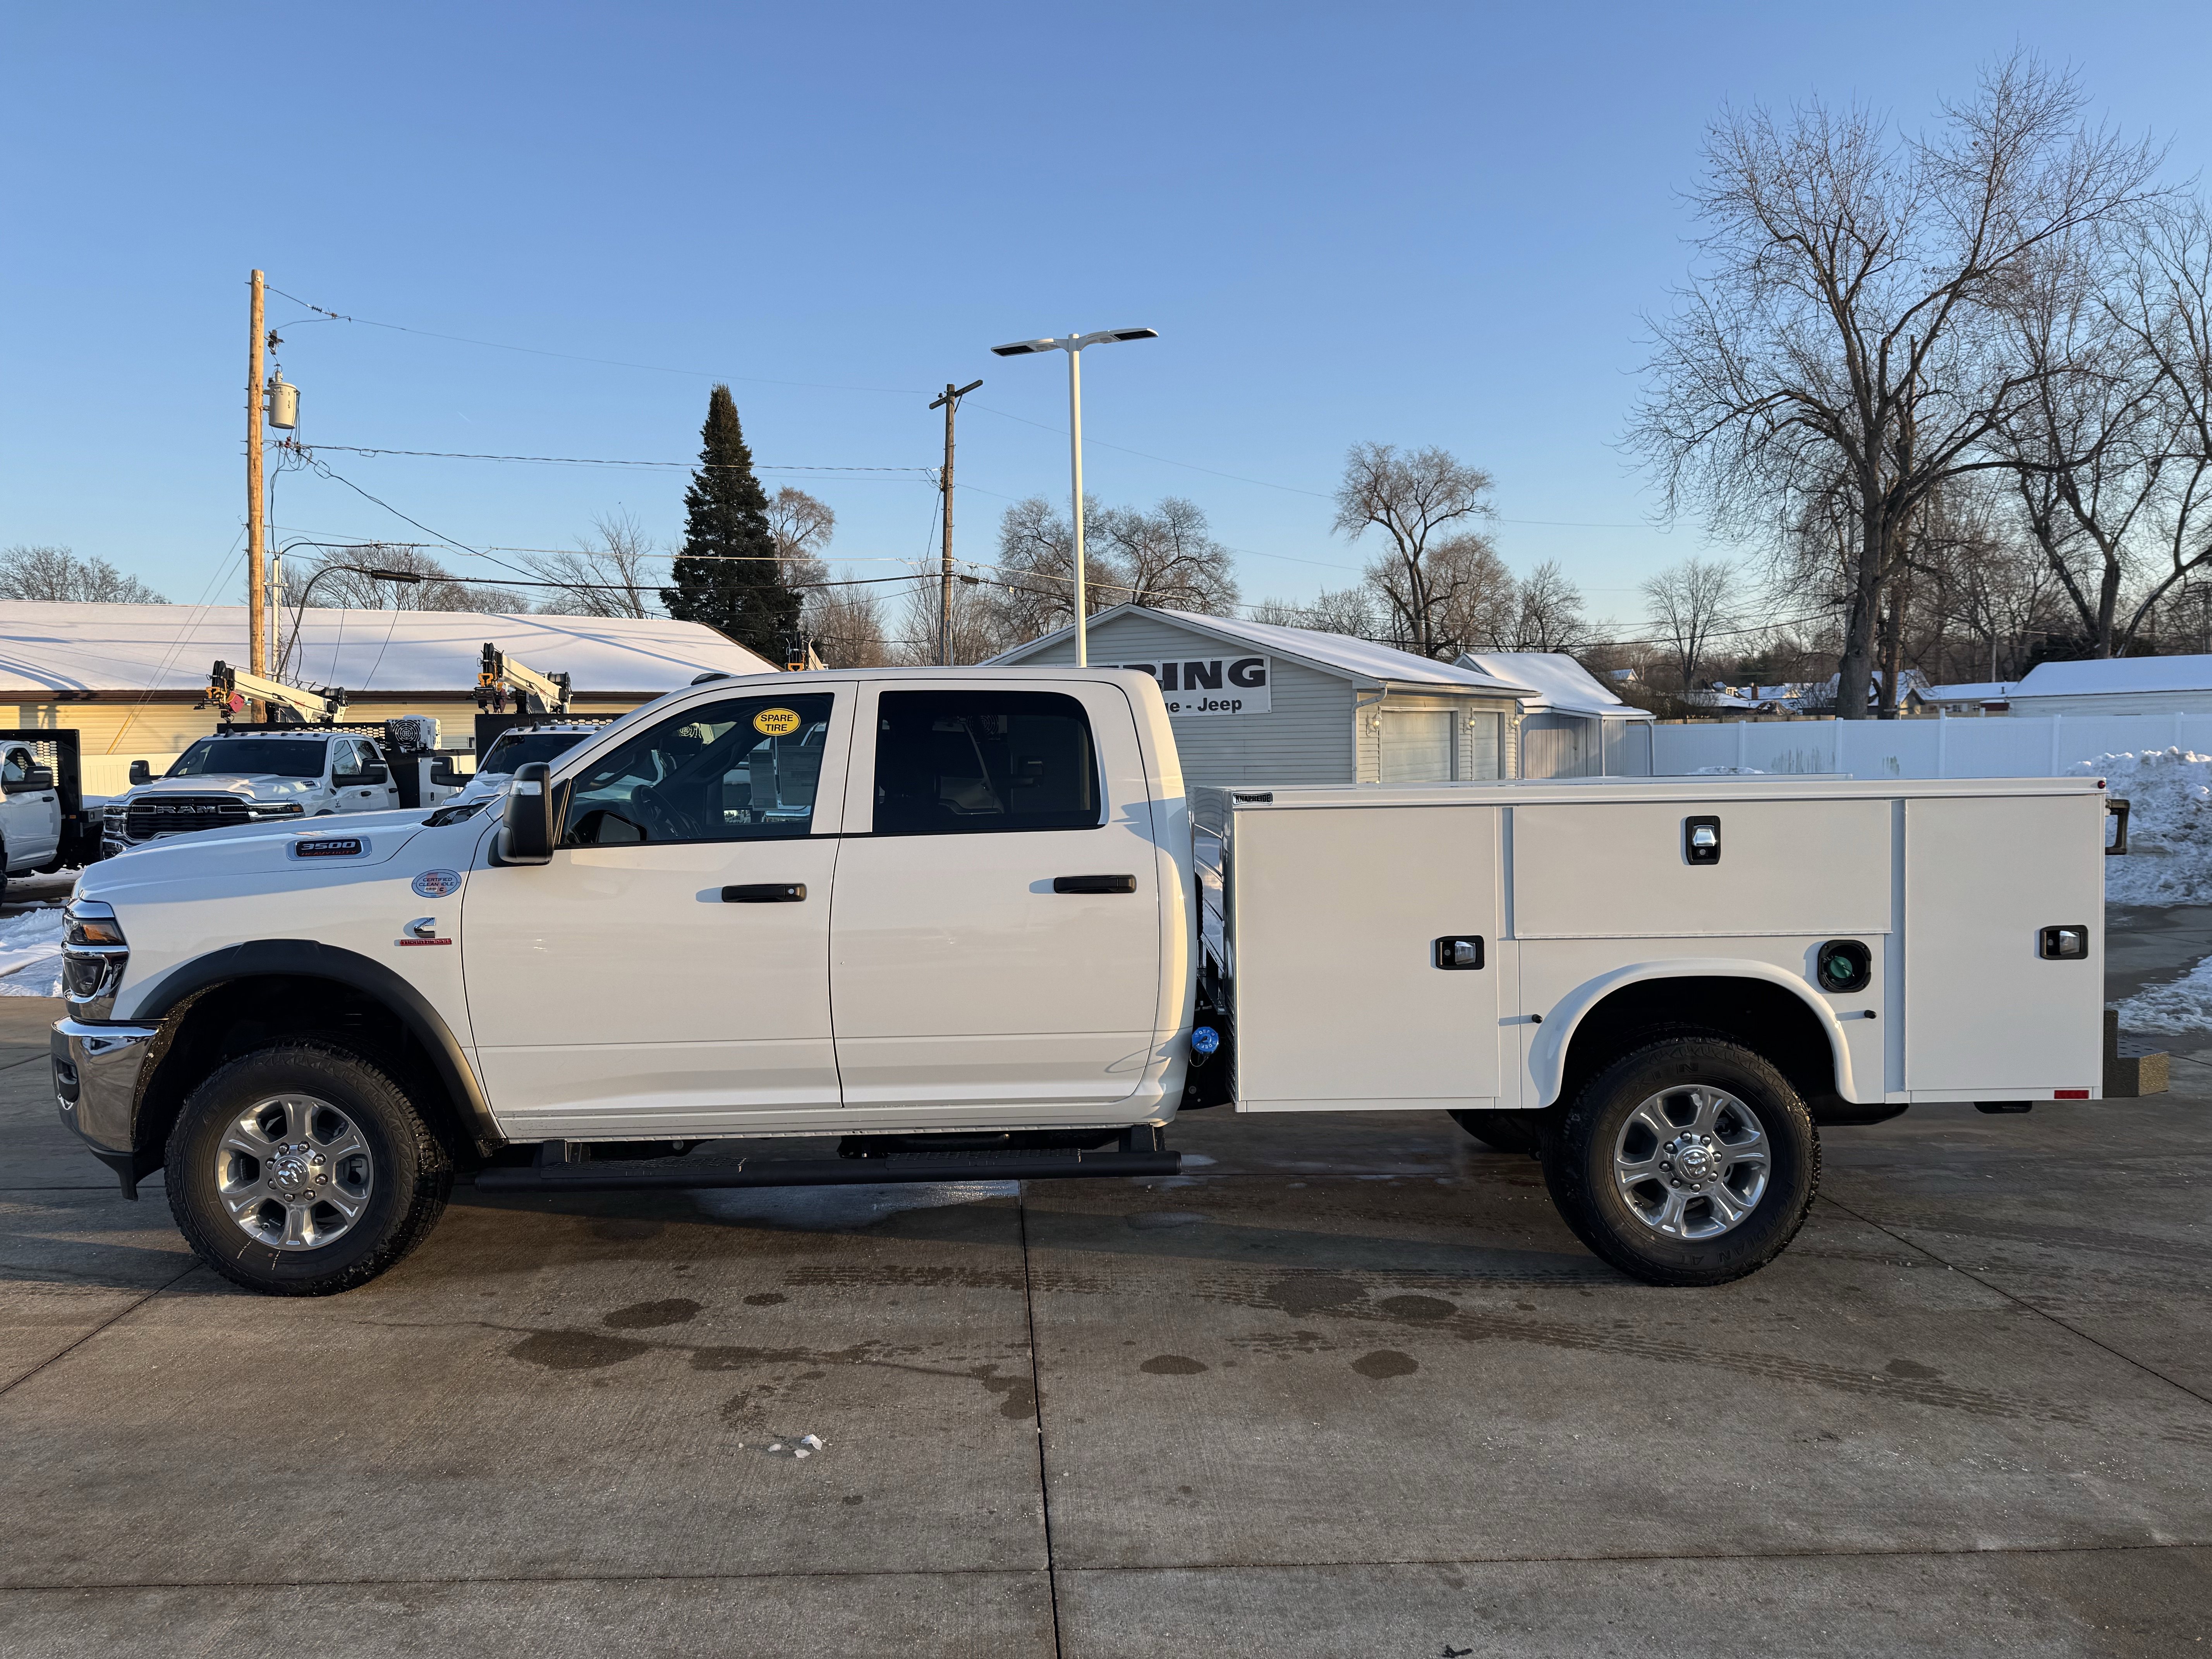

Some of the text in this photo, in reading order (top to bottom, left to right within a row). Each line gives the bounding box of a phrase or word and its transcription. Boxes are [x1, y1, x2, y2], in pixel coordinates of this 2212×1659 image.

[1087, 658, 1266, 691] ING
[1197, 697, 1242, 713] Jeep
[301, 842, 356, 850] 3500
